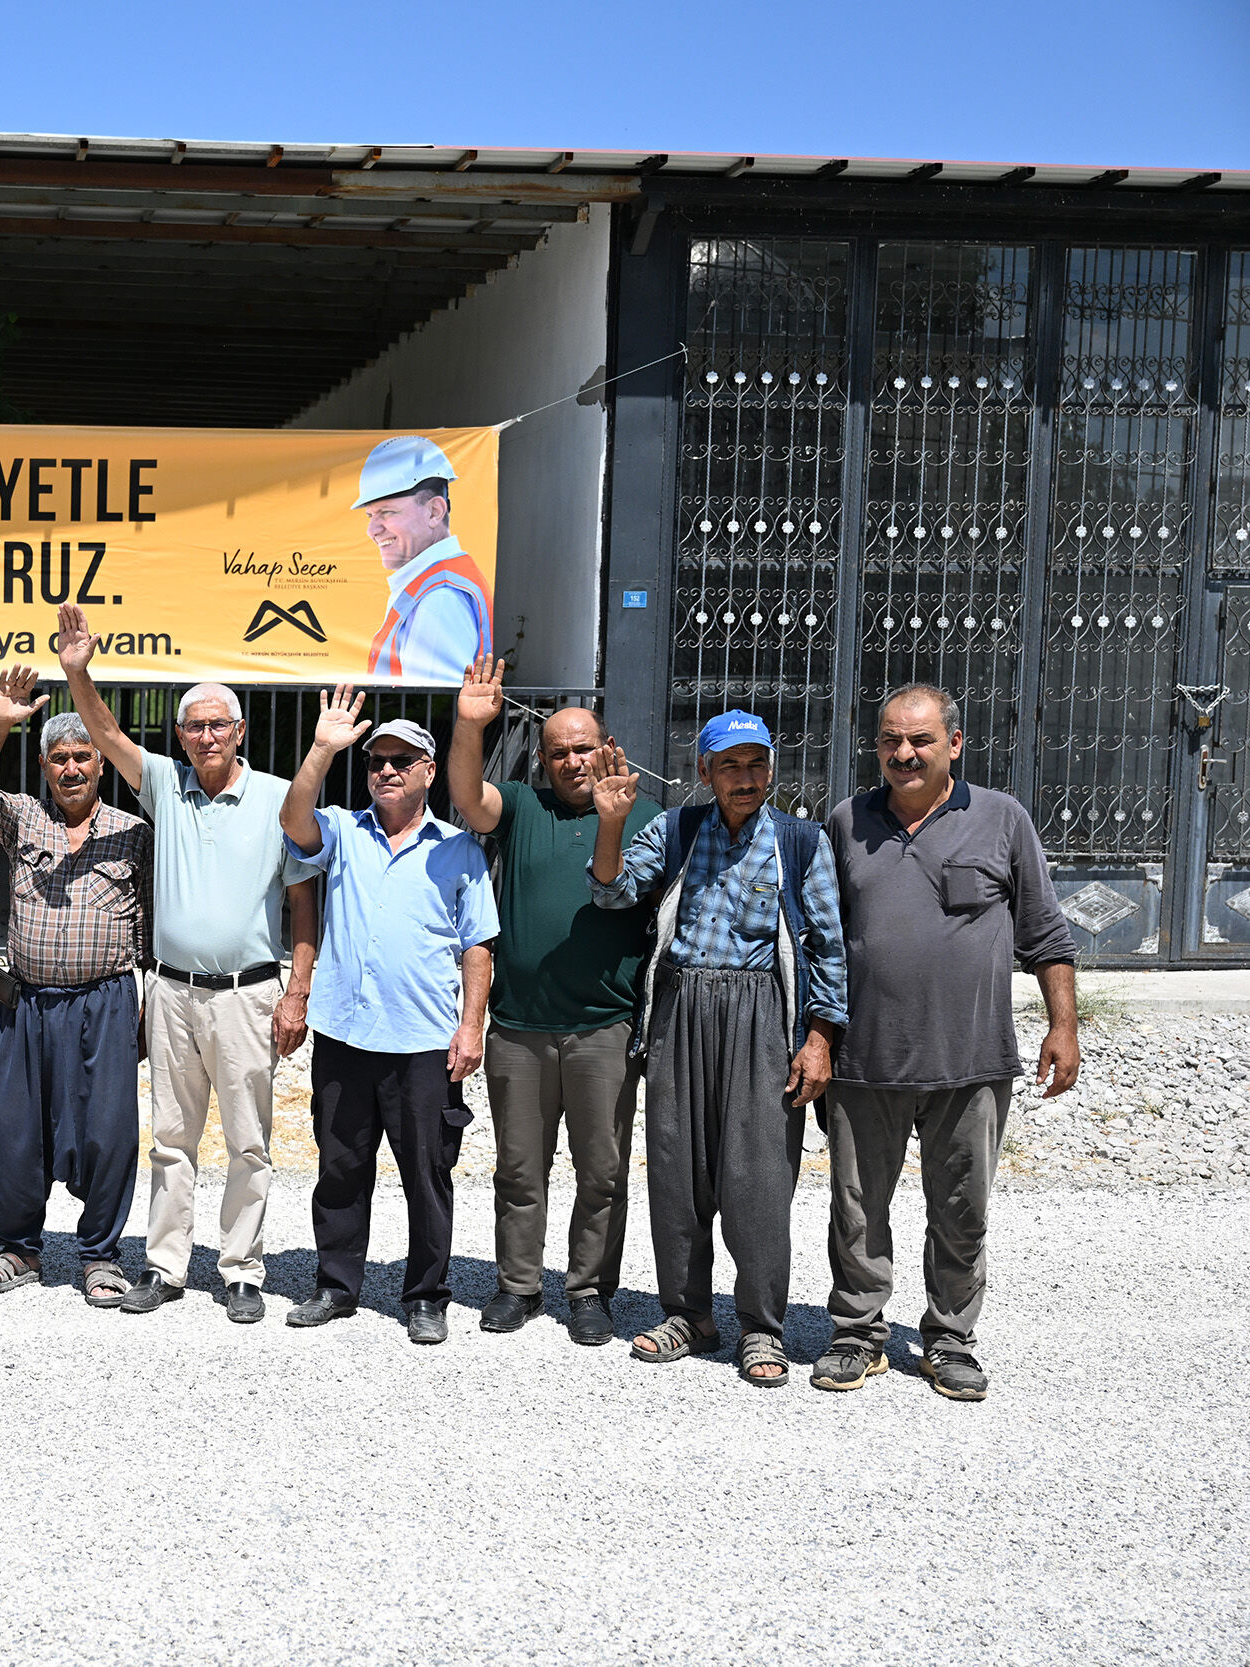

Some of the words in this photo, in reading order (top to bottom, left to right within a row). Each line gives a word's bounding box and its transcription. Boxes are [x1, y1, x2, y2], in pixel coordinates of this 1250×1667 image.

[223, 548, 283, 587] Vahap
[288, 551, 337, 577] Seçer
[48, 631, 182, 656] vam.
